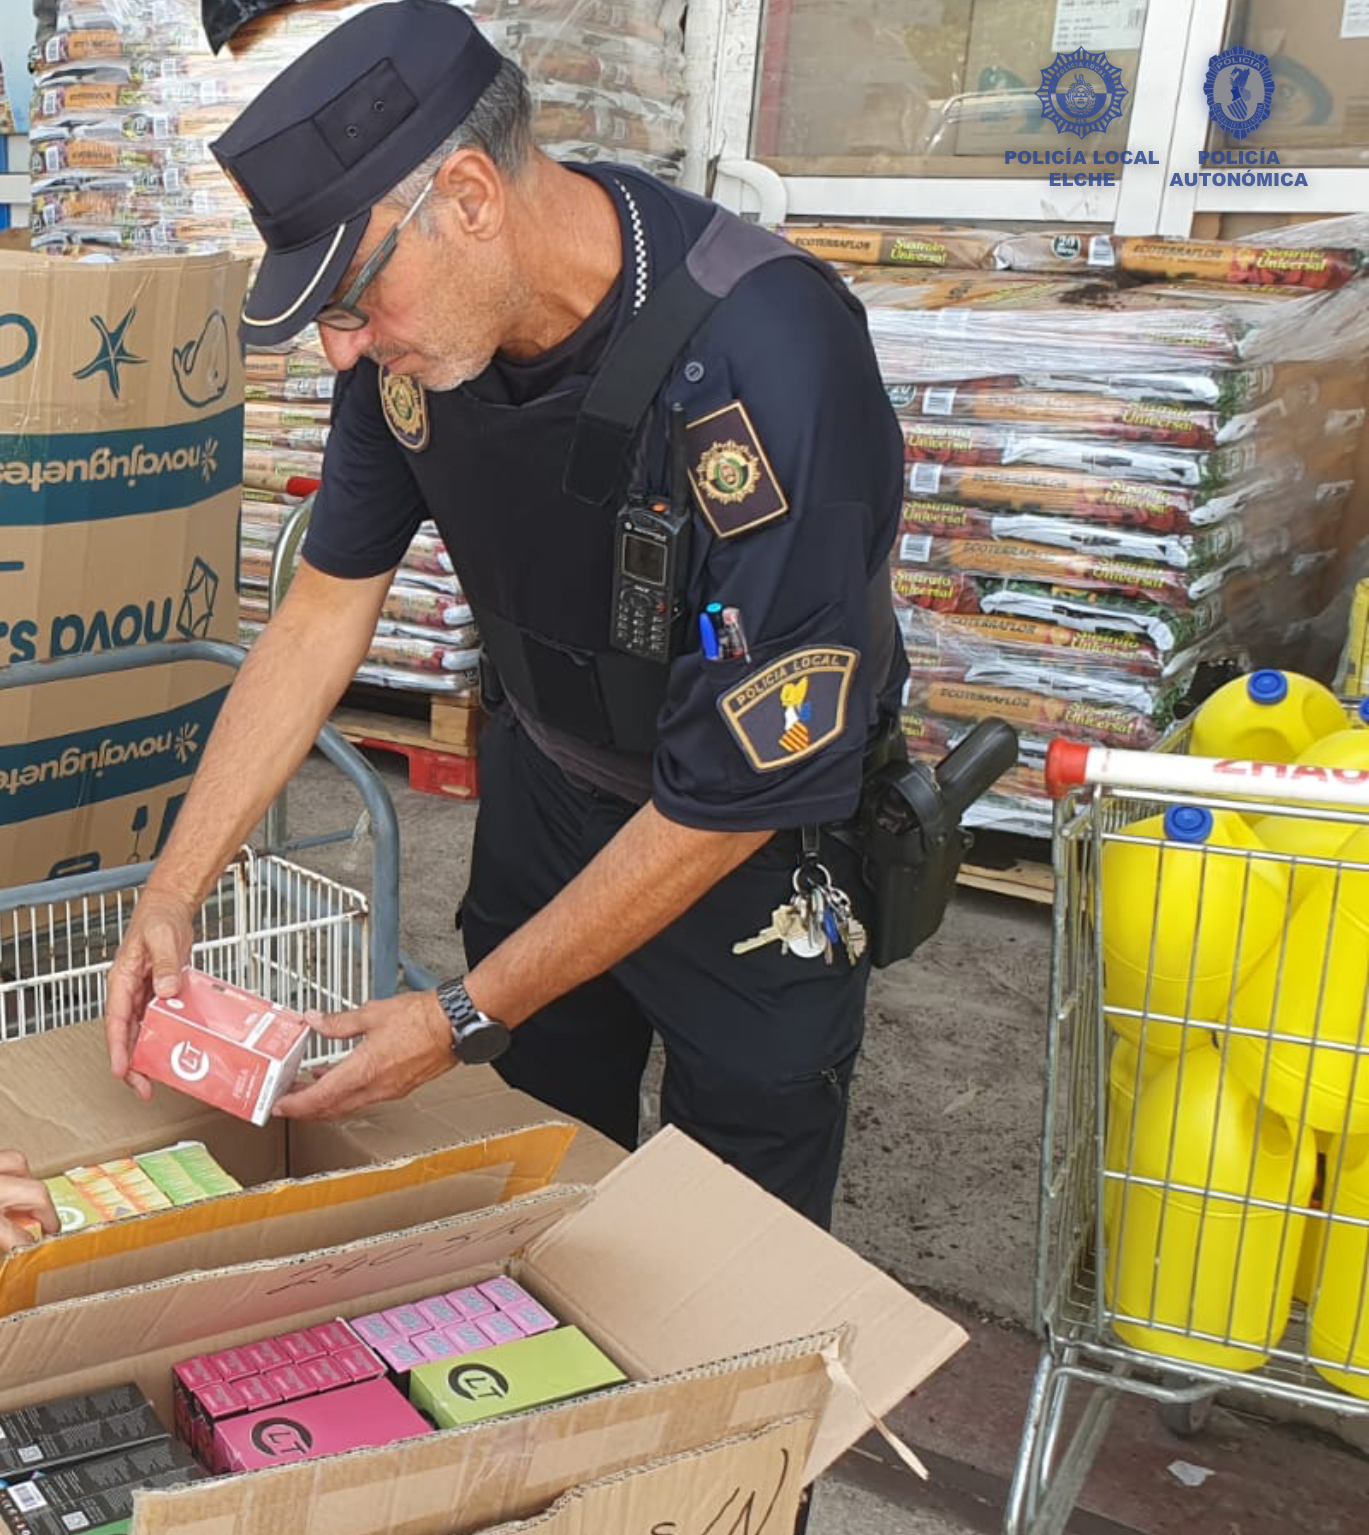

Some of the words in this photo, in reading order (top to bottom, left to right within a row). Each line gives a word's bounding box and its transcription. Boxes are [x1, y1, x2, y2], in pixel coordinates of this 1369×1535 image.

[49, 597, 172, 658] nova
[735, 667, 789, 707] POLICIA
[793, 654, 841, 671] LOCAL
